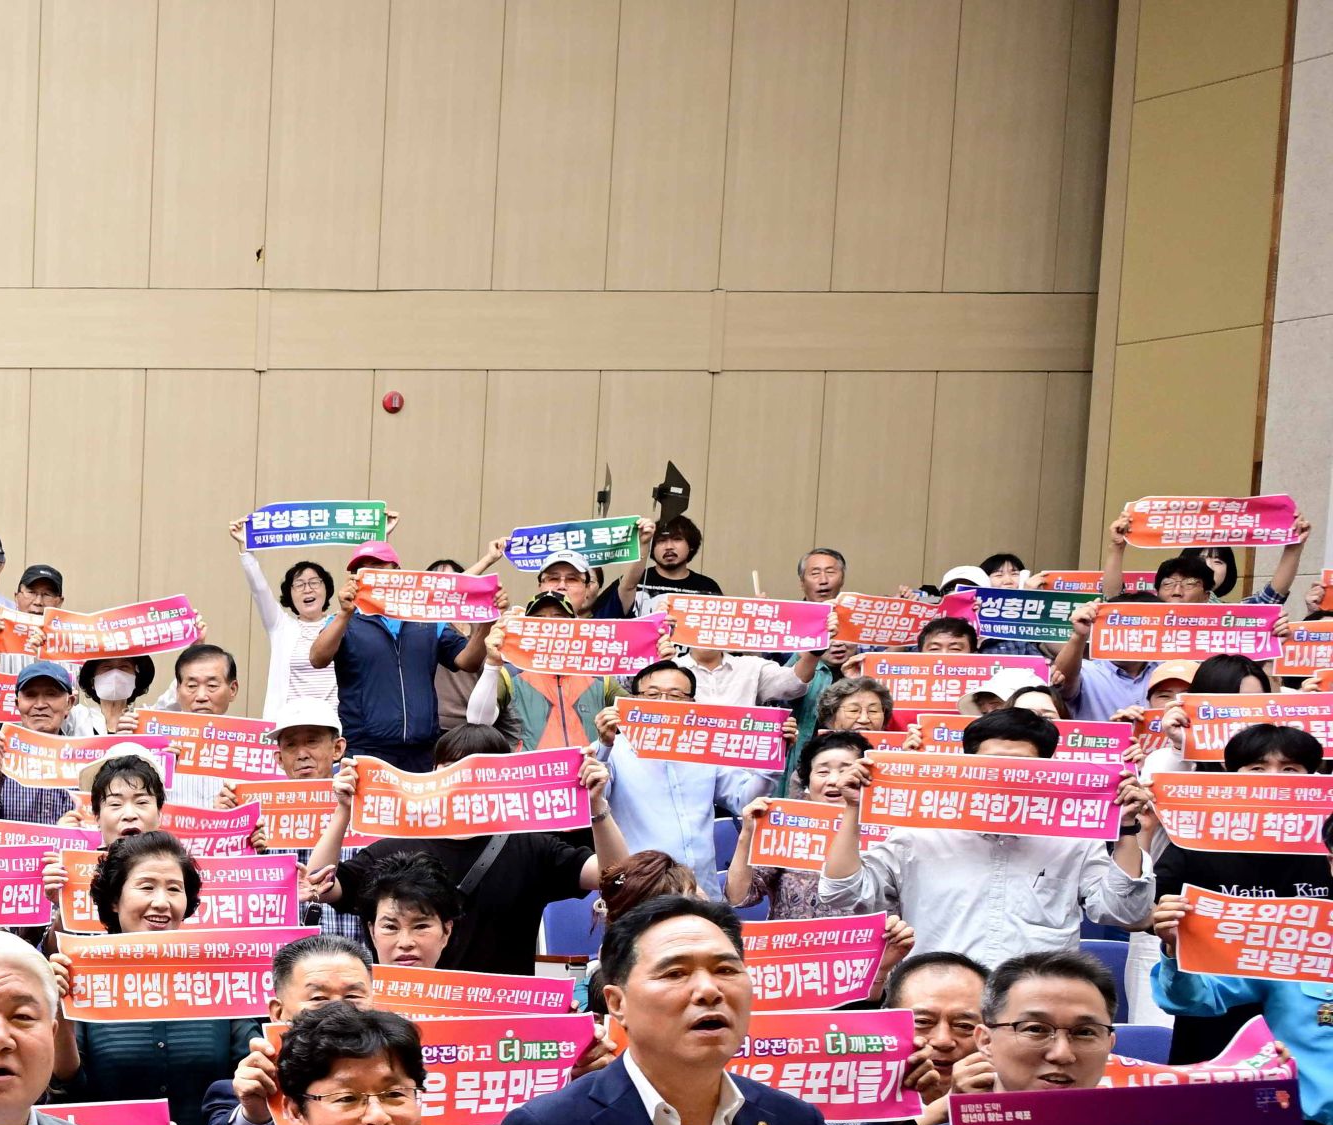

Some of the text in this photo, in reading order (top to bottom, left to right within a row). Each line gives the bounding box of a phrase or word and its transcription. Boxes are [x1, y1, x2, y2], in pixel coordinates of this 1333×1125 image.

[252, 508, 380, 529] 감성충만 목포!
[511, 525, 632, 555] 감성충만 목포!
[684, 615, 791, 634] 우리와의 약속!
[697, 631, 778, 648] 관광객과의
[1099, 630, 1272, 654] 다시찾고 싶은 목포만들기
[918, 764, 956, 778] 관광객
[961, 768, 999, 782] 시대를
[1077, 774, 1109, 788] 다짐!
[362, 787, 577, 827] 친절! 위생! 착한가격! 안전!
[871, 788, 1109, 828] 친절! 위생! 착한가격! 안전!
[1220, 883, 1329, 898] Matin Kim
[73, 971, 257, 1008] 친절! 위생! 착한가격!
[755, 1037, 820, 1056] 안전하고
[850, 1035, 898, 1056] 깨끗한
[777, 1060, 906, 1104] 목포만들기
